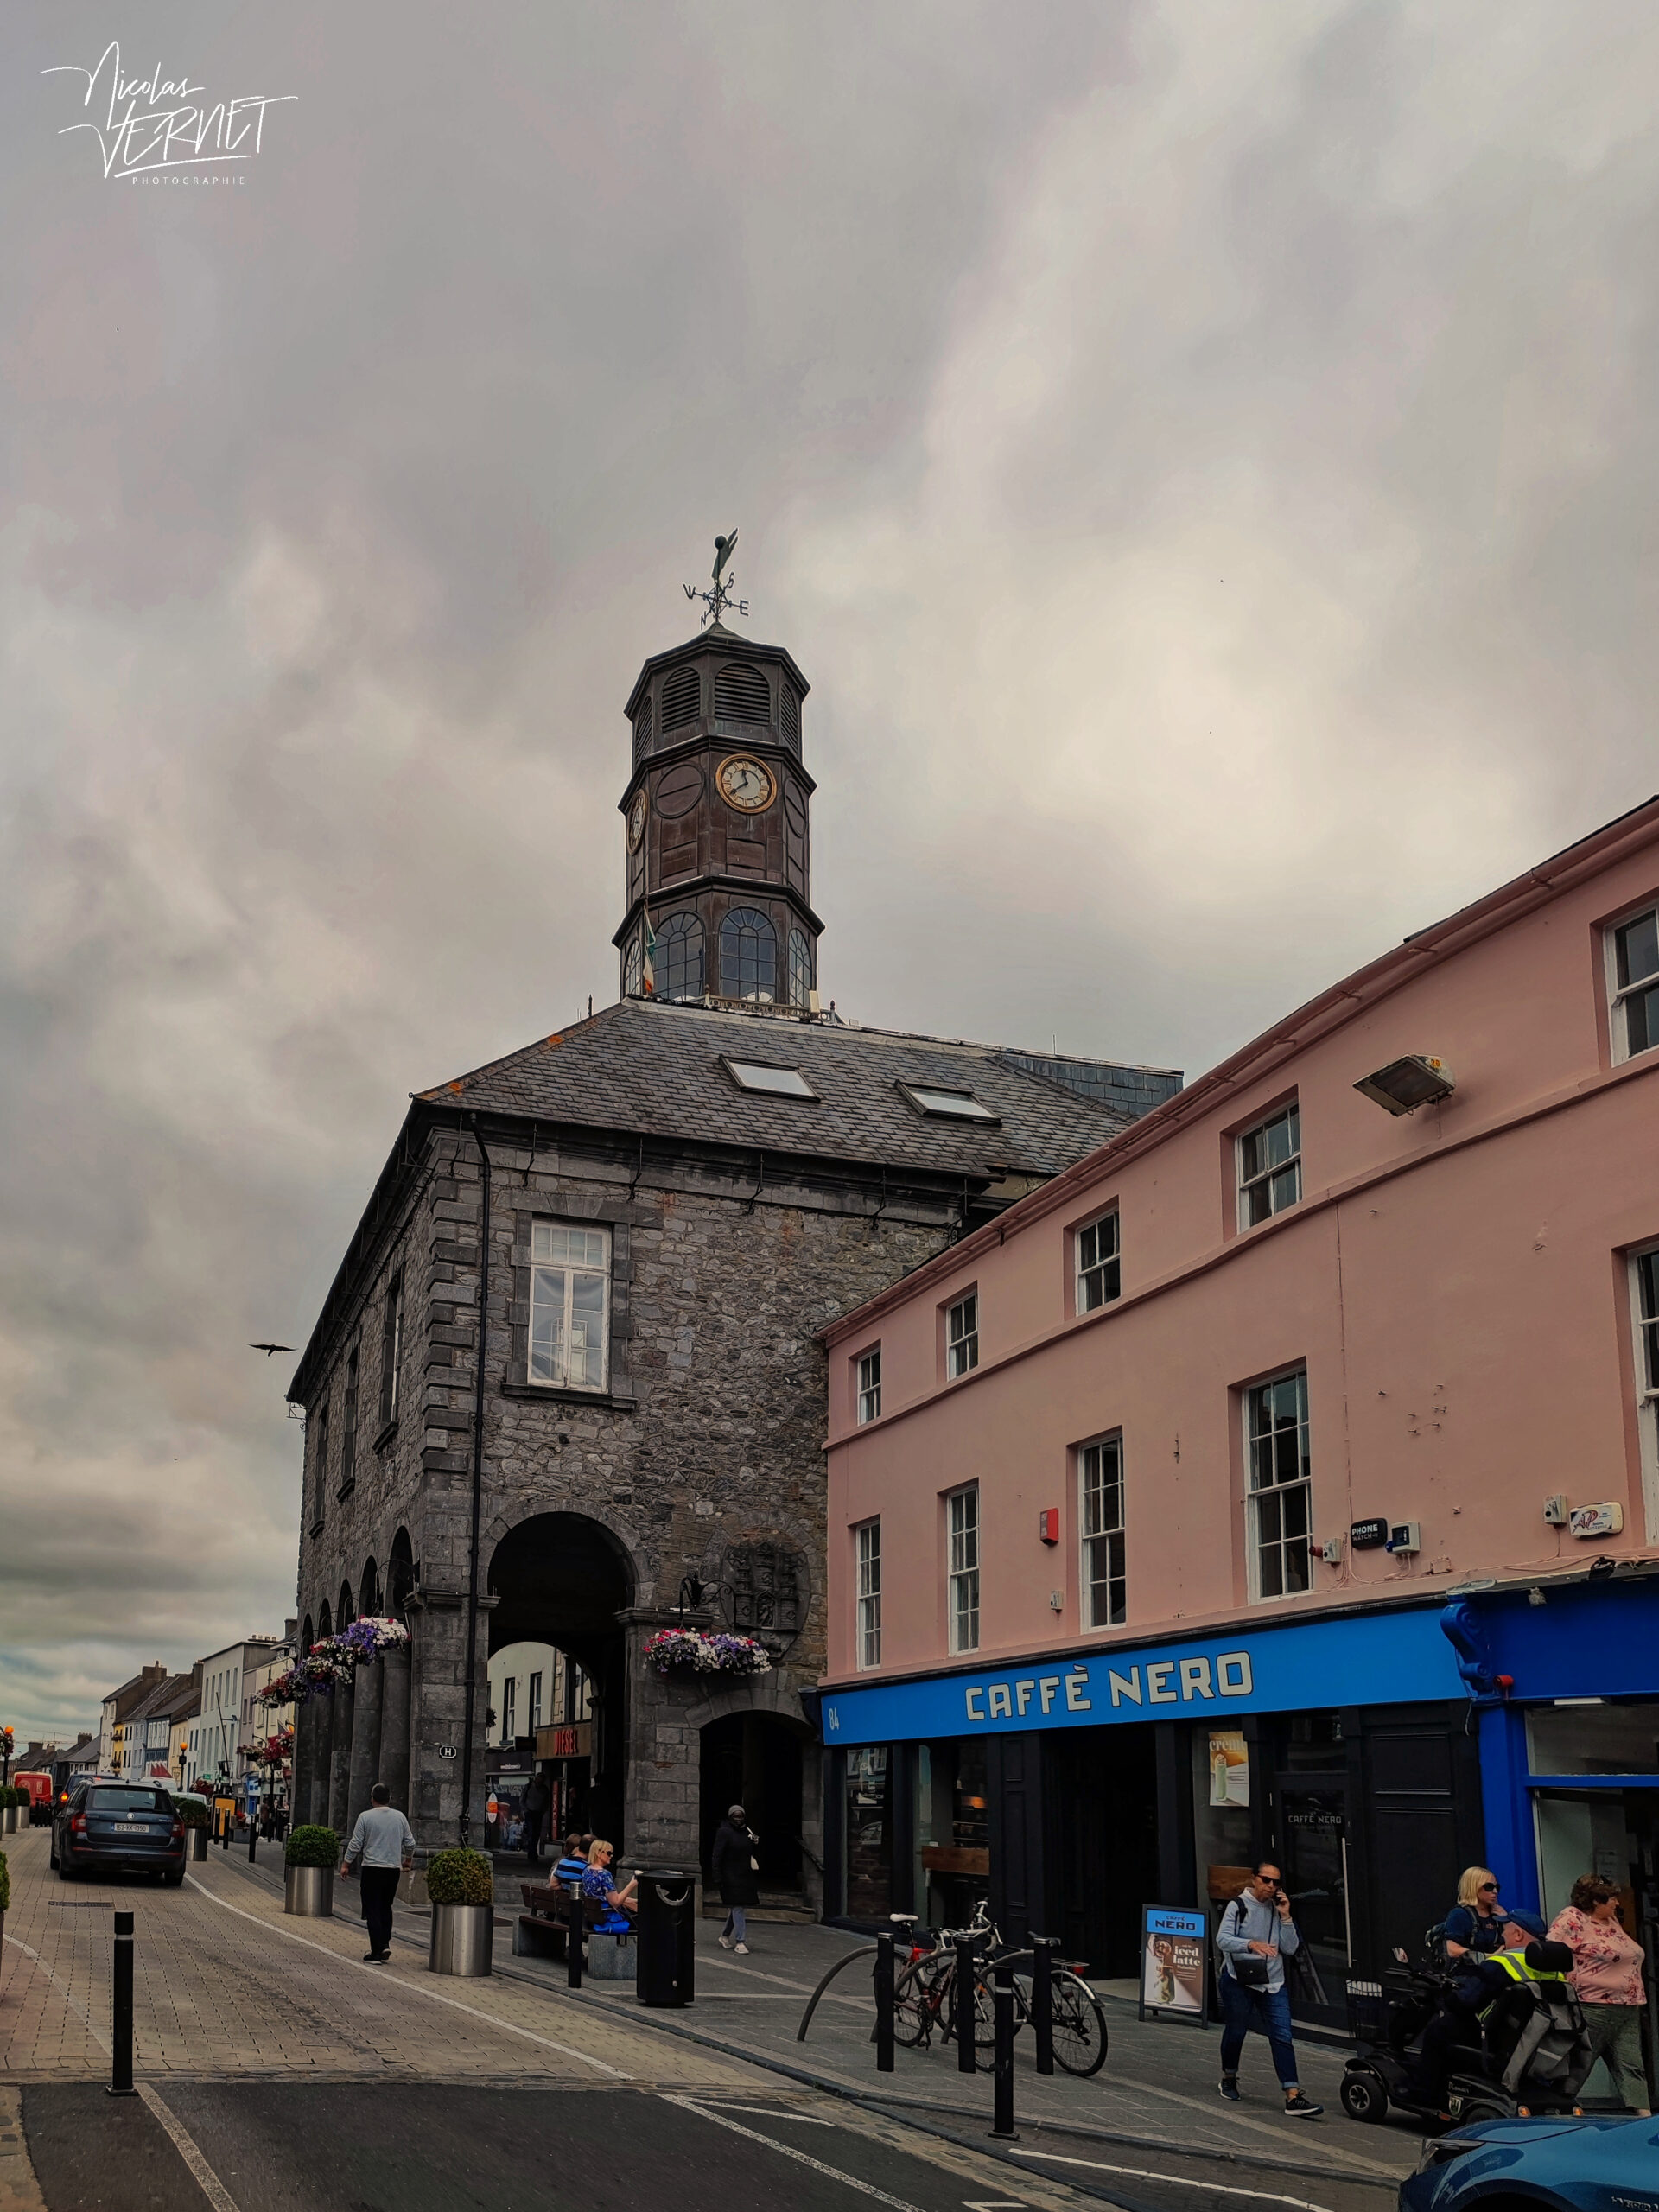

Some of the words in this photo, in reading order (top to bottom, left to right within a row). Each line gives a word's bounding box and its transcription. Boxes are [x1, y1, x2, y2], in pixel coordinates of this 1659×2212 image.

[1351, 1523, 1378, 1535] PHONE
[1352, 1533, 1372, 1541] WATCH
[964, 1664, 1092, 1721] CAFFÈ
[1108, 1650, 1254, 1707] NERO
[829, 1707, 840, 1731] 84
[554, 1729, 578, 1756] DIESEL
[444, 1747, 452, 1757] H
[1318, 1815, 1342, 1824] NERO
[1155, 1920, 1196, 1931] NERO
[1174, 1945, 1199, 1957] iced
[1173, 1955, 1201, 1967] latte
